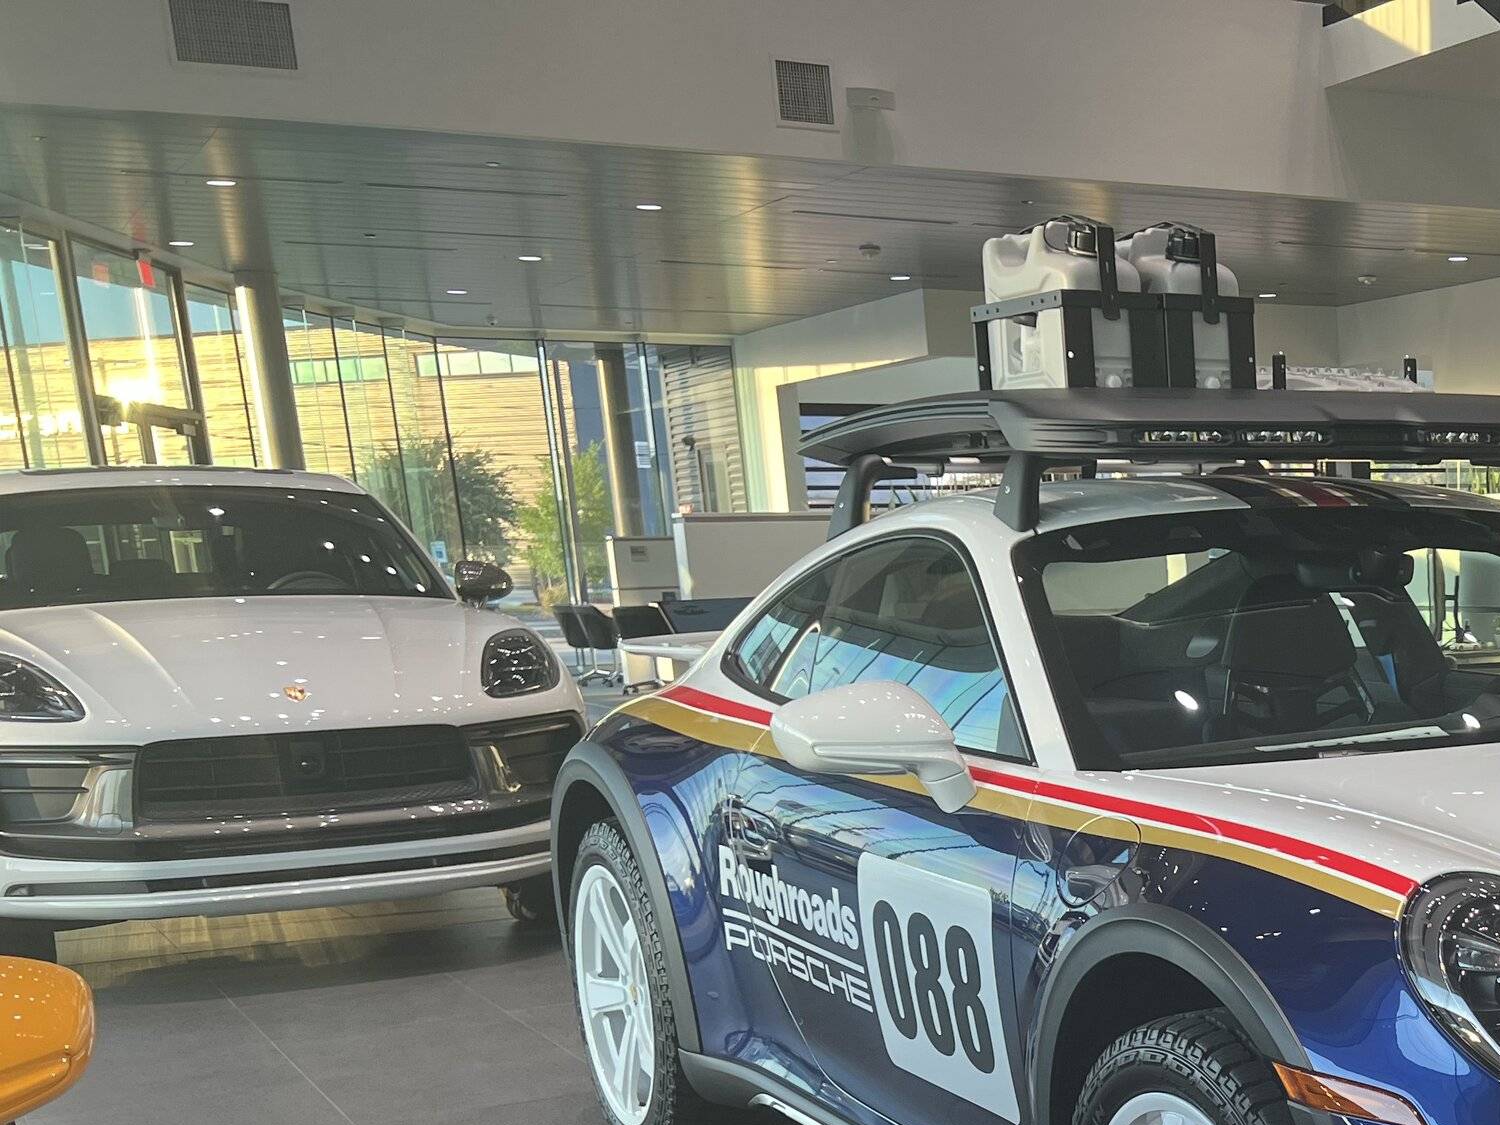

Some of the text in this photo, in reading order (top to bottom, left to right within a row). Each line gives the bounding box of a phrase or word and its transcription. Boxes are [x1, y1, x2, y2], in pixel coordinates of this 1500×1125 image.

[719, 846, 860, 950] Roughroads
[725, 922, 874, 1013] PORSCHE
[874, 900, 995, 1074] 088
